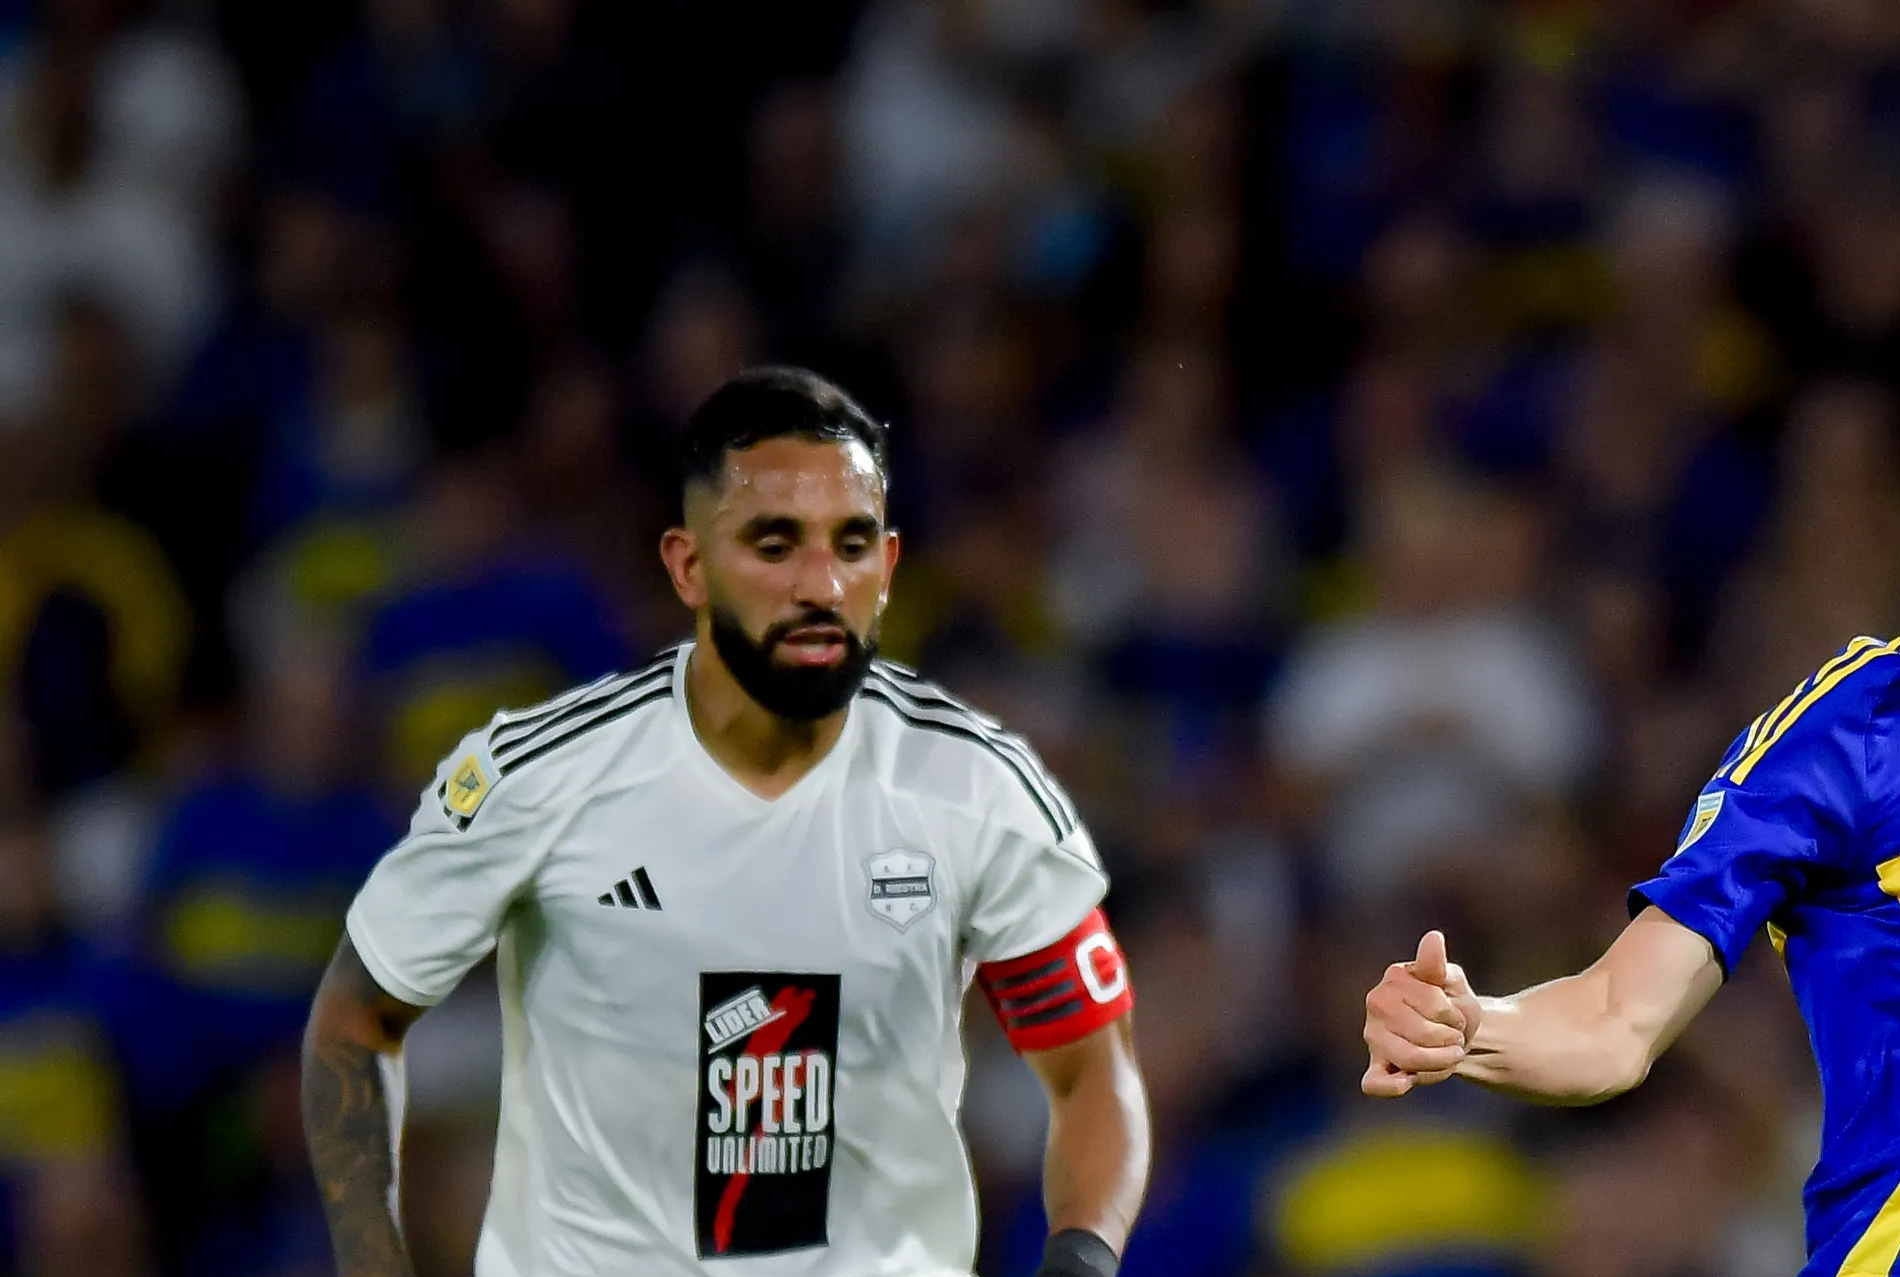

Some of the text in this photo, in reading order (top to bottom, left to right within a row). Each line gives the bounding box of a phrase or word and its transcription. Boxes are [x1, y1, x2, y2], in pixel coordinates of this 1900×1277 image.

[1075, 932, 1124, 1004] C
[704, 993, 771, 1044] LIDER
[707, 1053, 829, 1134] SPEED
[706, 1136, 828, 1174] UNLIMITED
